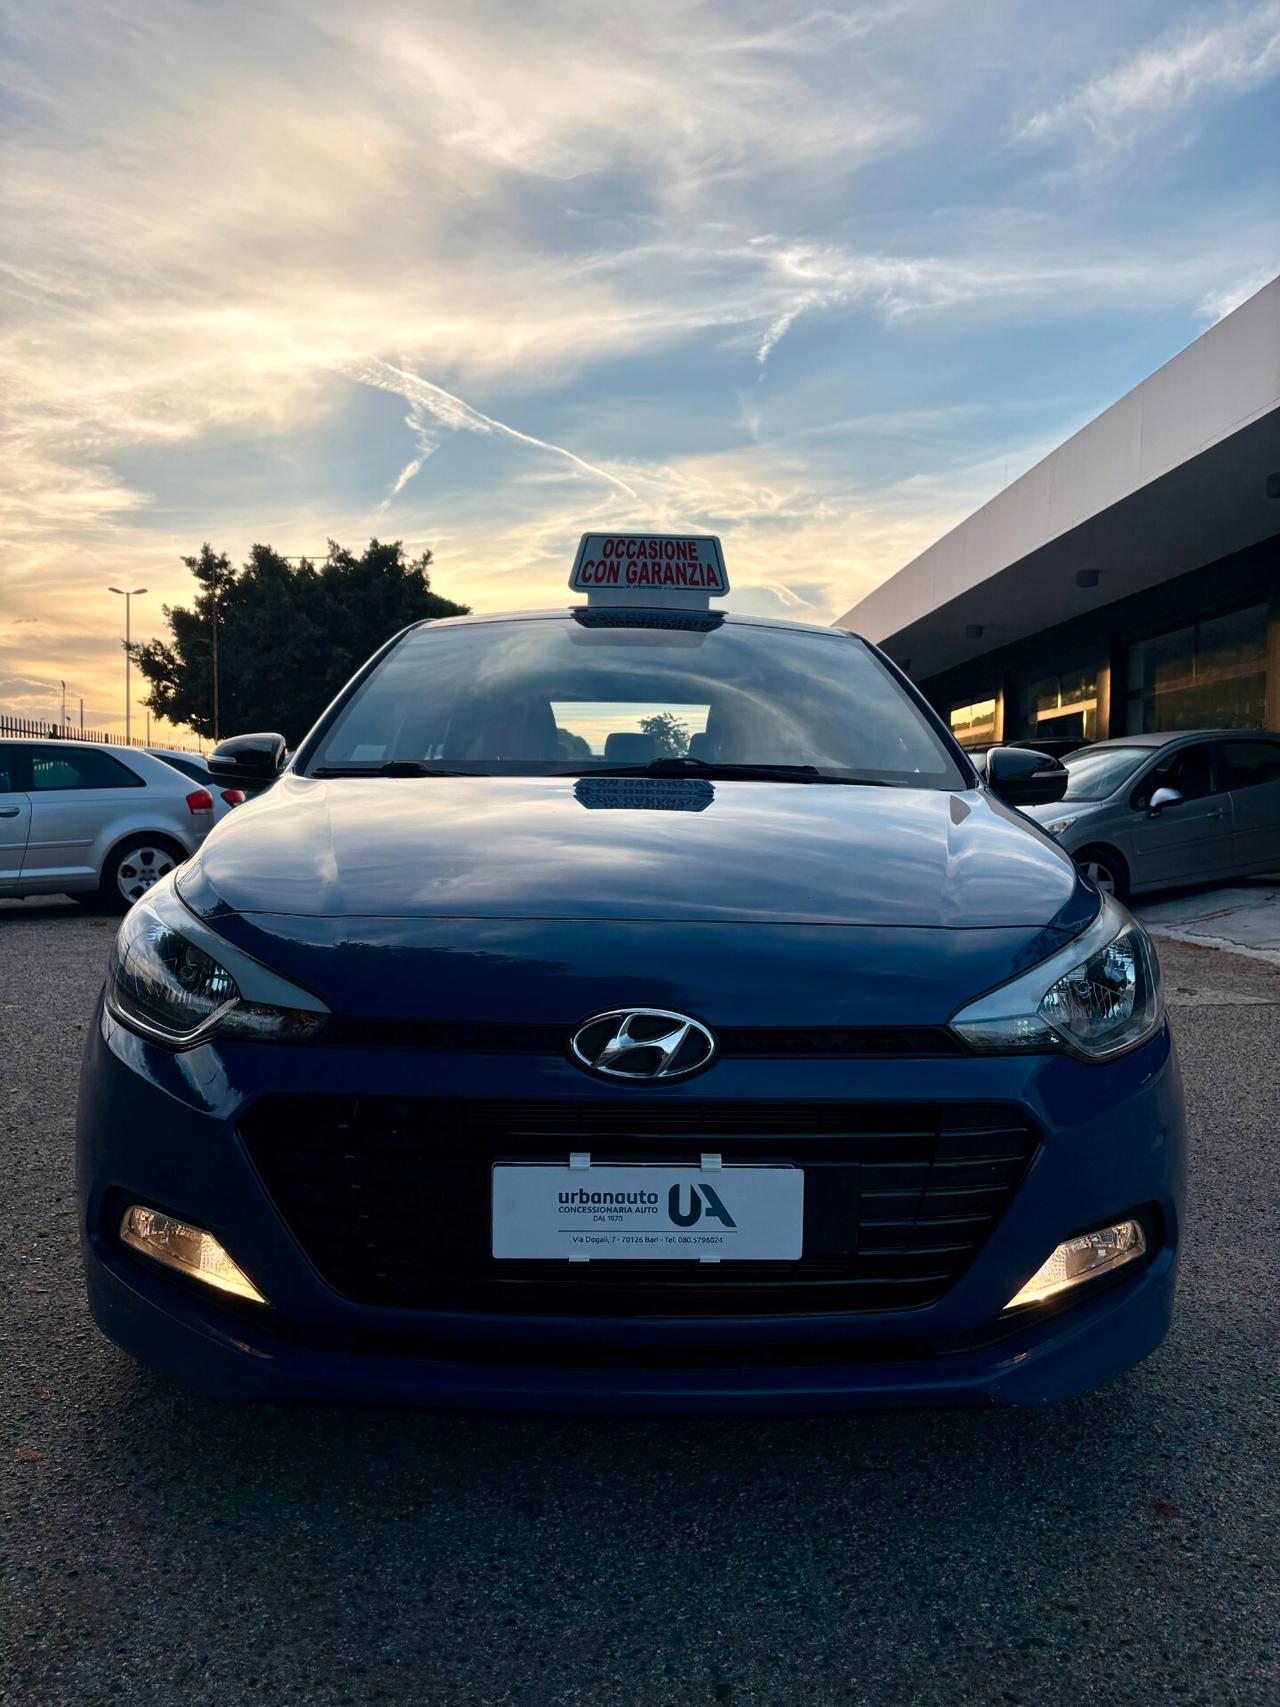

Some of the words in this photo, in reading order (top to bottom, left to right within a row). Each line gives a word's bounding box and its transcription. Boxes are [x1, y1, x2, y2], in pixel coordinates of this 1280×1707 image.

[602, 538, 699, 561] OCCASIONE
[581, 559, 621, 584] CON
[625, 560, 720, 587] GARANZIA
[558, 1188, 658, 1204] urbanauto
[668, 1183, 737, 1228] UA
[558, 1206, 633, 1214] CONCESSIONARIA
[634, 1206, 658, 1214] AUTO
[585, 1236, 609, 1244] Dogali,
